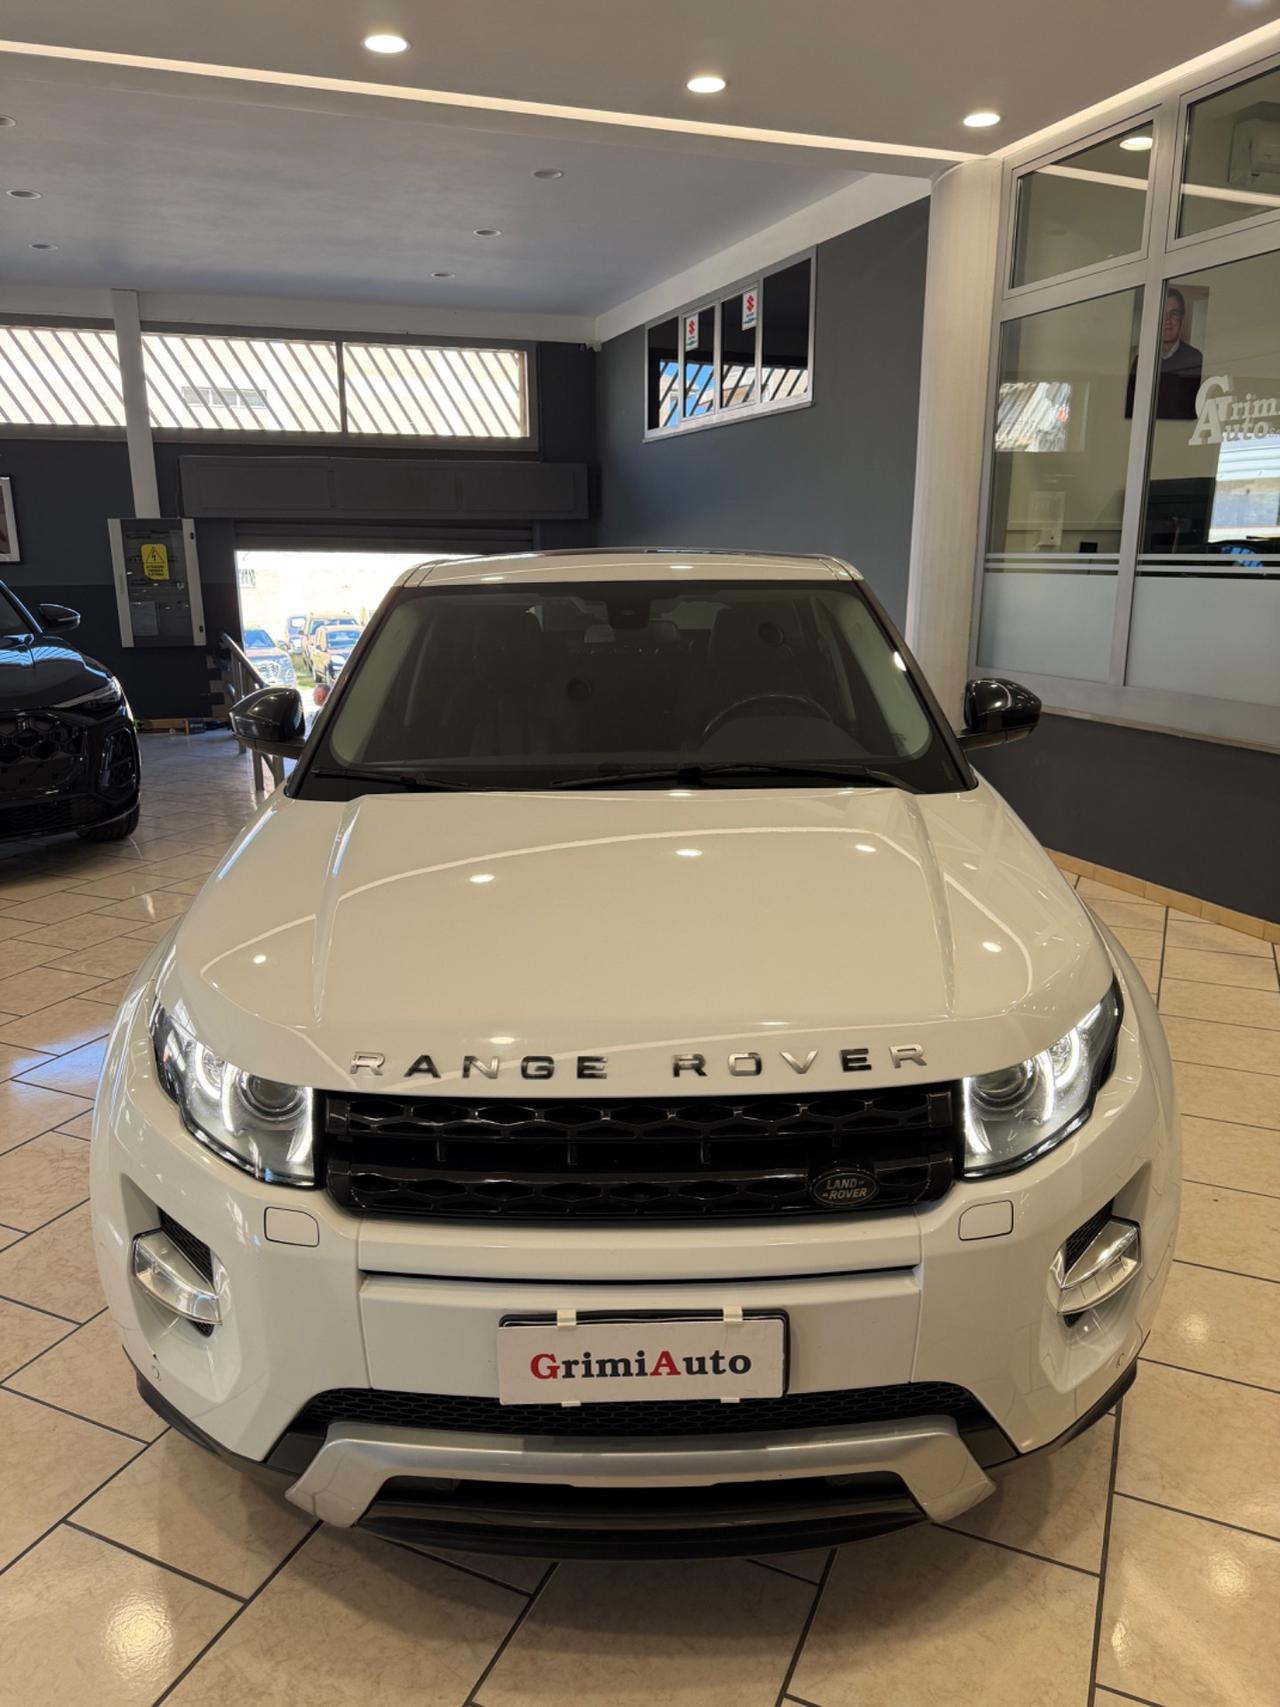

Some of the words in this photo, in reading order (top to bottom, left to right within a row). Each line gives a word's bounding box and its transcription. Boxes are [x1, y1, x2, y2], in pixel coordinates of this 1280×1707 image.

[1195, 375, 1280, 421] Grim
[1188, 399, 1269, 446] Auto
[351, 1051, 608, 1080] RANGE
[672, 1044, 927, 1078] ROVER
[826, 1178, 858, 1190] LAND
[828, 1187, 867, 1200] ROVER
[530, 1350, 752, 1380] GrimiAuto
